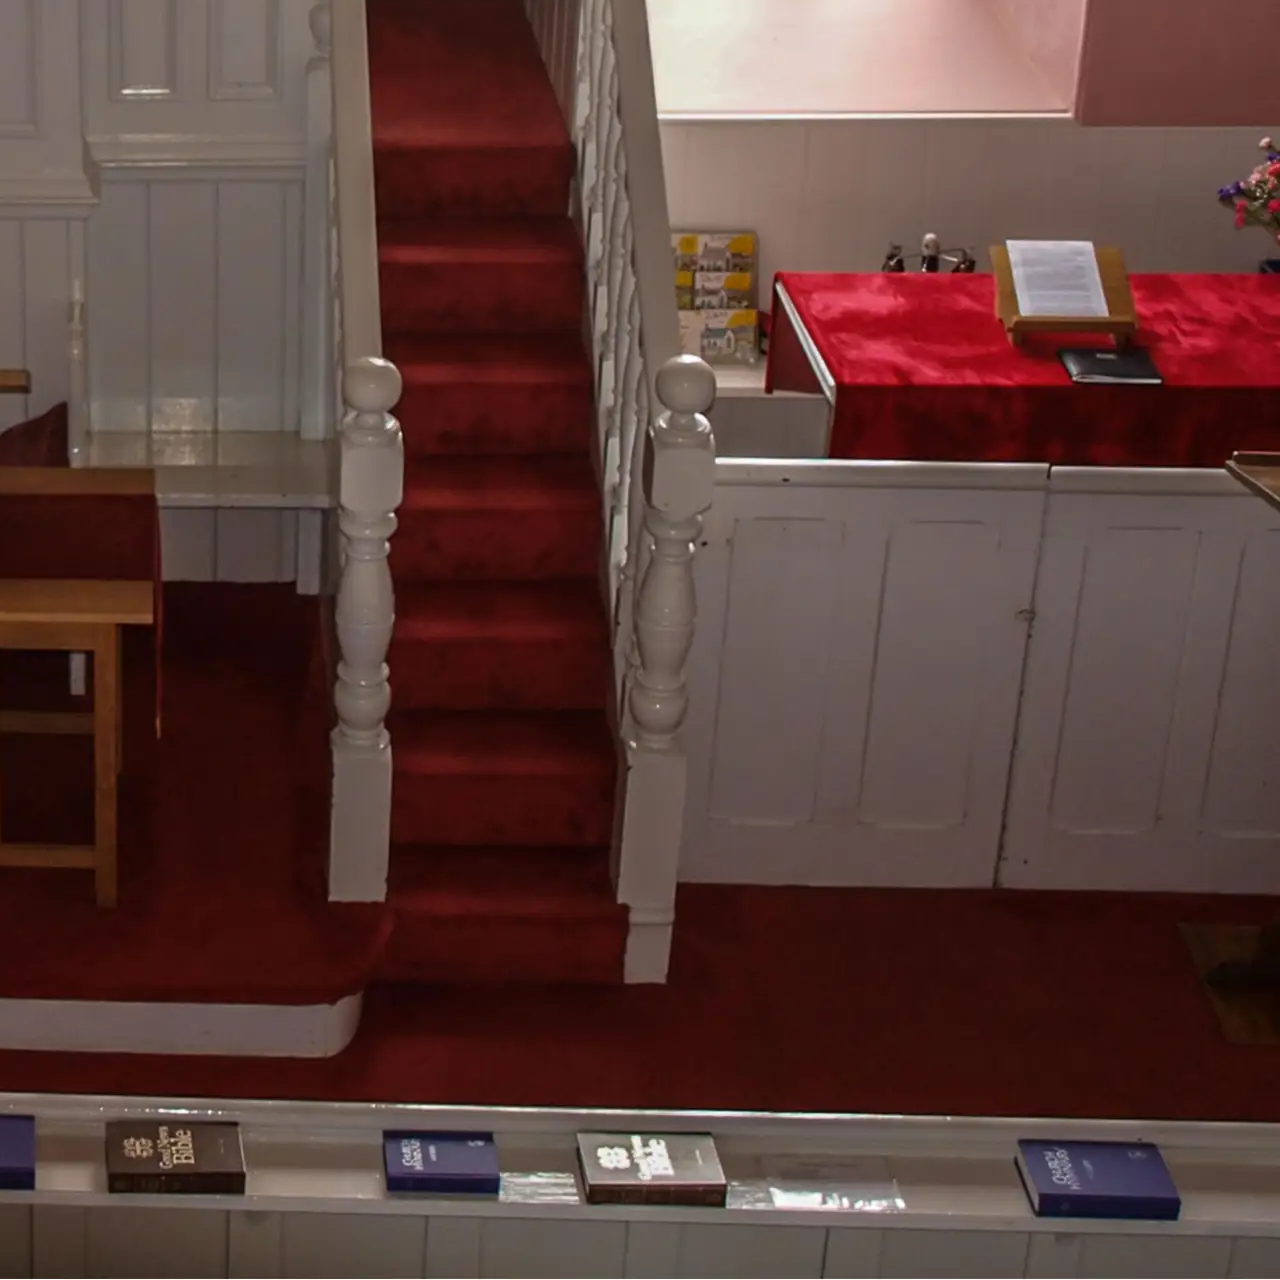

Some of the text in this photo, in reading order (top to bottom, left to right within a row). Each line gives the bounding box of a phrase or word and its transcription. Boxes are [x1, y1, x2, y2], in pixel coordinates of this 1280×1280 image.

[157, 1125, 173, 1169] Good News
[171, 1129, 195, 1165] Bible
